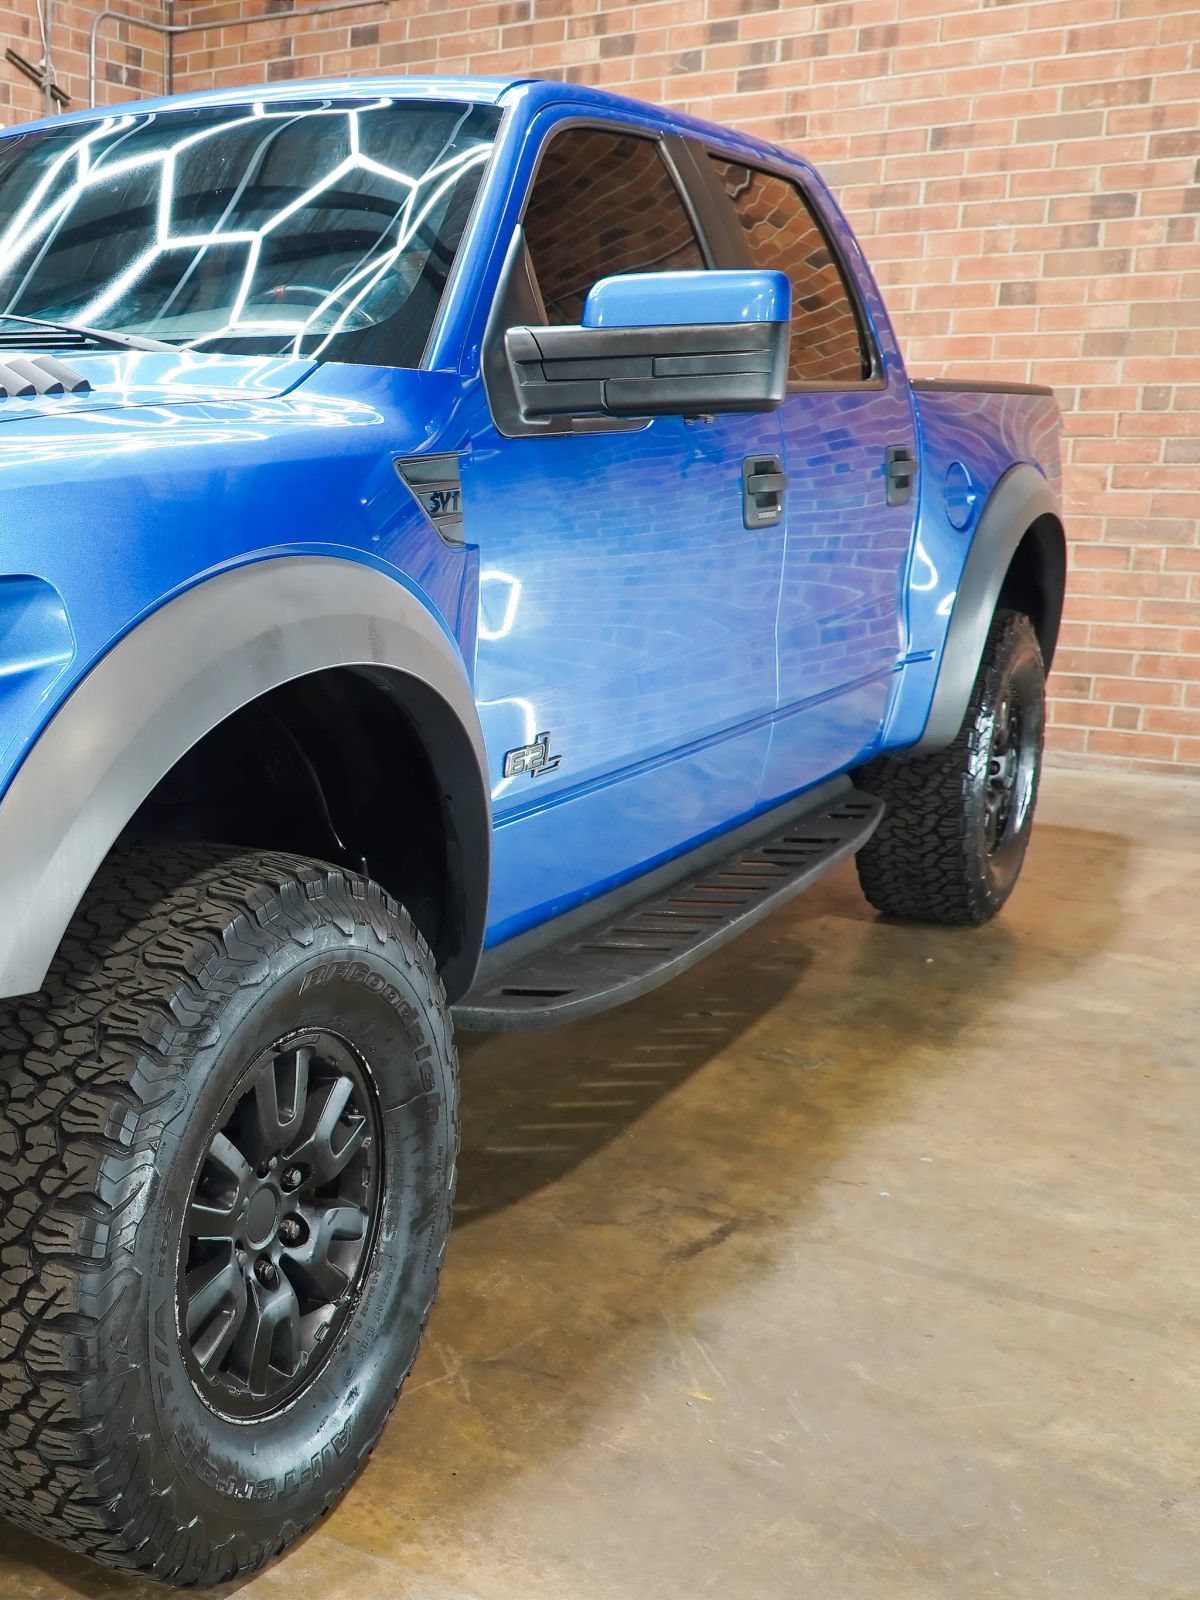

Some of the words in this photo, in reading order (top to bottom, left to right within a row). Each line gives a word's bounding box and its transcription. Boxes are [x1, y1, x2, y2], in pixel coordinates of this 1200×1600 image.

[430, 491, 461, 512] SVT
[502, 731, 562, 778] 6.2L
[299, 960, 441, 1125] BFGoodrich
[175, 1415, 353, 1504] All-Terrain
